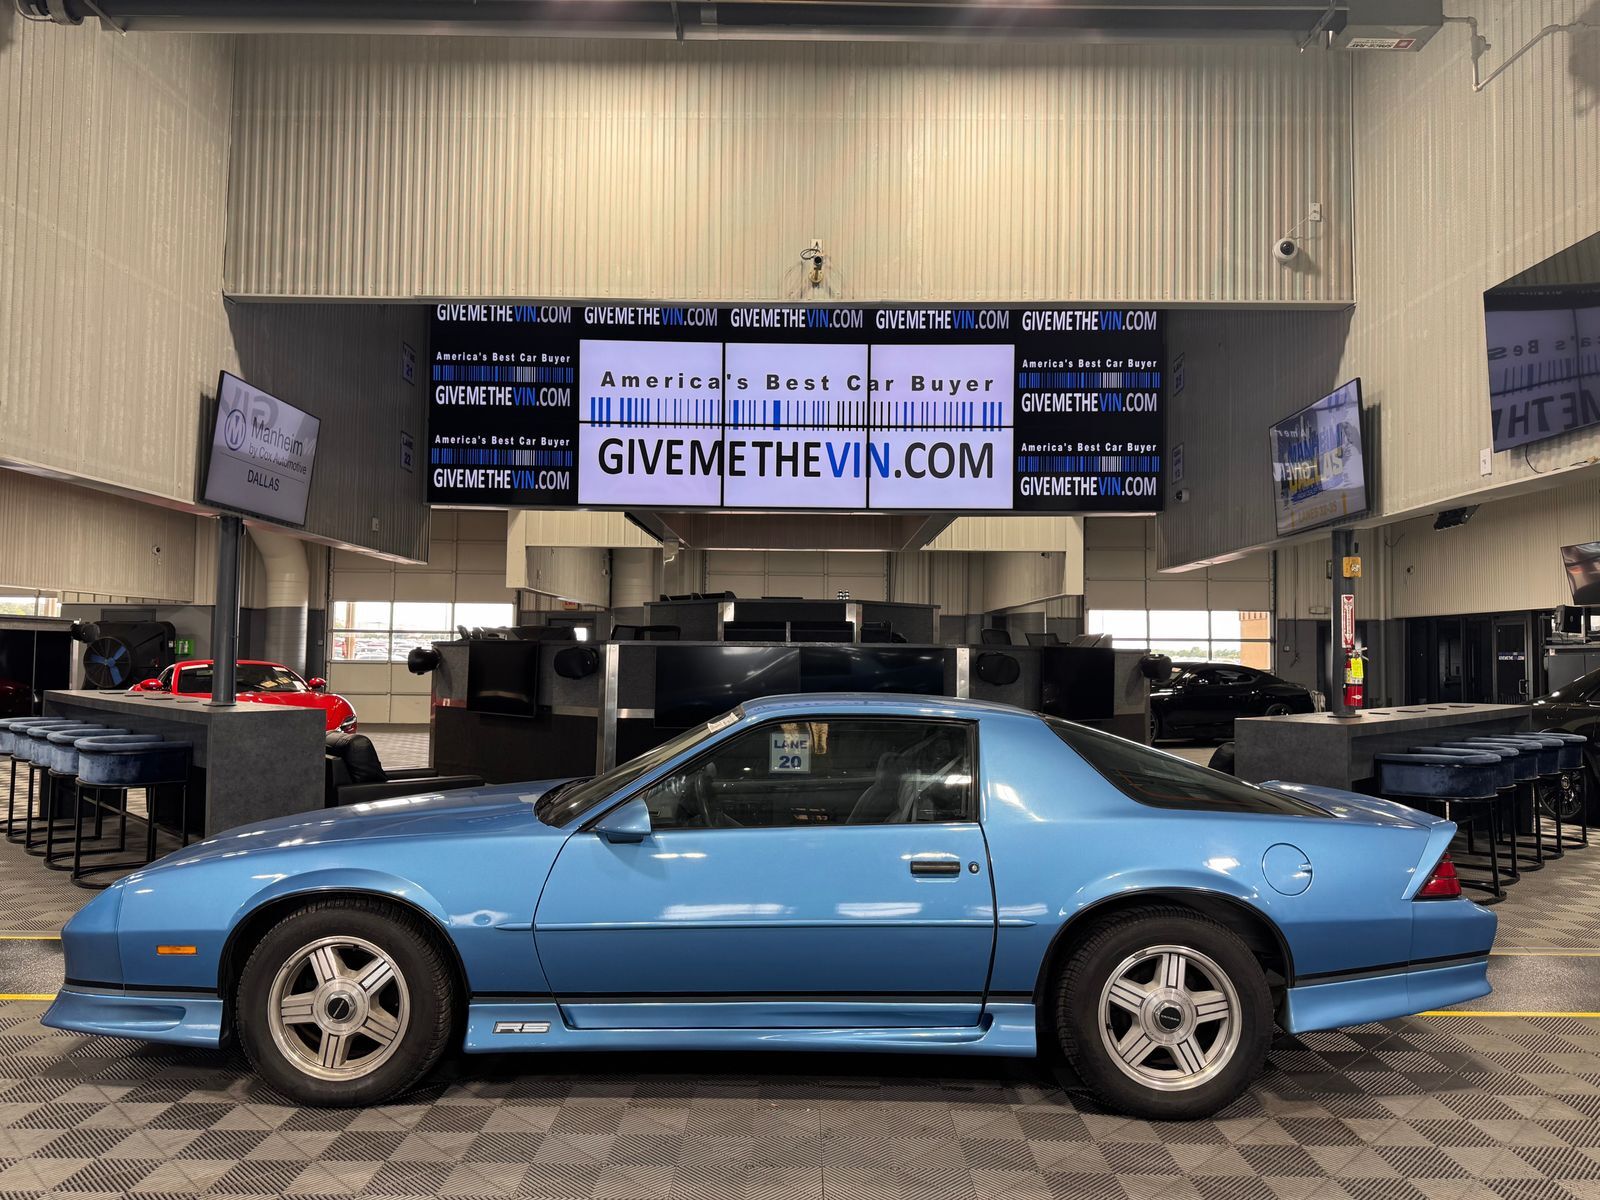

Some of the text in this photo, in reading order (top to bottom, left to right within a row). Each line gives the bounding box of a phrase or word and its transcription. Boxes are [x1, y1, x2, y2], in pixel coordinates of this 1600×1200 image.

[437, 304, 572, 323] GIVEMETHEVIN.COM
[584, 307, 718, 326] GIVEMETHEVIN.COM
[730, 309, 863, 328] GIVEMETHEVIN.COM
[876, 310, 1010, 330] GIVEMETHEVIN.COM
[1022, 311, 1157, 331] GIVEMETHEVIN.COM
[436, 351, 570, 364] America's Best Car Buyer
[1022, 359, 1157, 370] America's Best Car Buyer
[600, 370, 995, 396] America's Best Car Buyer
[435, 385, 571, 407] GIVEMETHEVIN.COM
[1021, 392, 1157, 413] GIVEMETHEVIN.COM
[251, 416, 304, 457] Manheim
[434, 434, 570, 448] America's Best Car Buyer
[598, 437, 994, 479] GIVEMETHEVIN.COM
[1021, 442, 1157, 454] America's Best Car Buyer
[248, 443, 307, 475] by Cox Automotive
[247, 469, 280, 492] DALLAS
[433, 468, 570, 490] GIVEMETHEVIN.COM
[1020, 476, 1157, 496] GIVEMETHEVIN.COM
[774, 739, 807, 750] LANE
[779, 755, 802, 768] 20
[493, 1021, 551, 1033] RS
